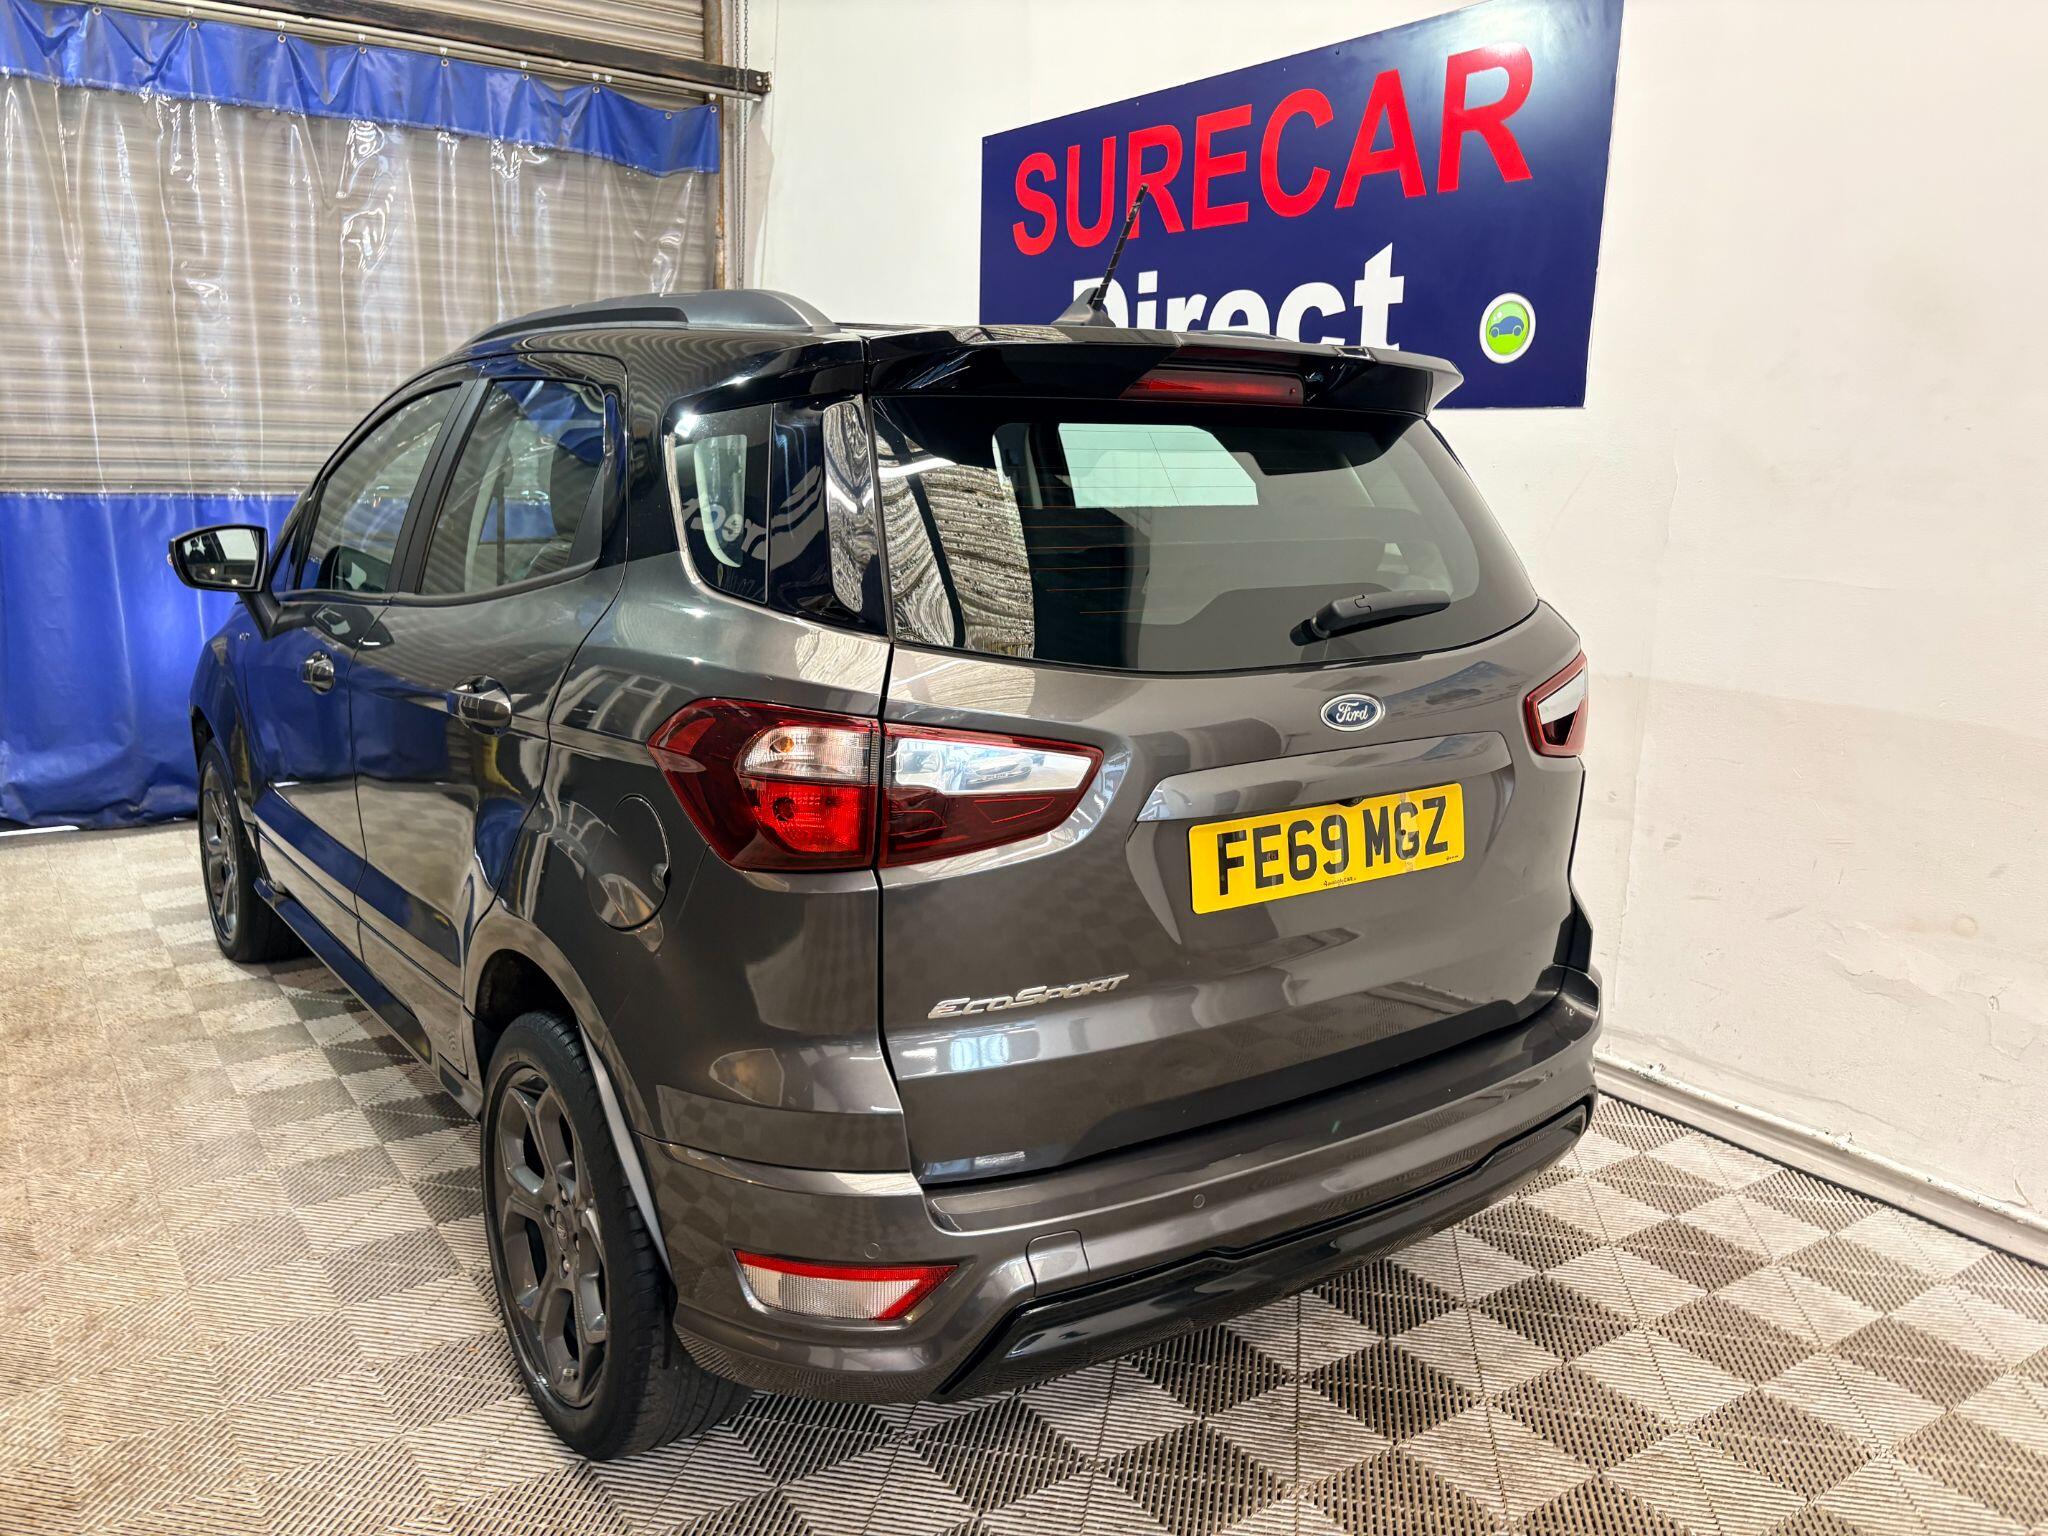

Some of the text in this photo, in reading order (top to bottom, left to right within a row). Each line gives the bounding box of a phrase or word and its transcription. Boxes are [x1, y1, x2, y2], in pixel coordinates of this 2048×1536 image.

[1012, 41, 1533, 256] SURECAR
[1335, 701, 1369, 724] Ford
[1216, 795, 1449, 897] FE69 MGZ
